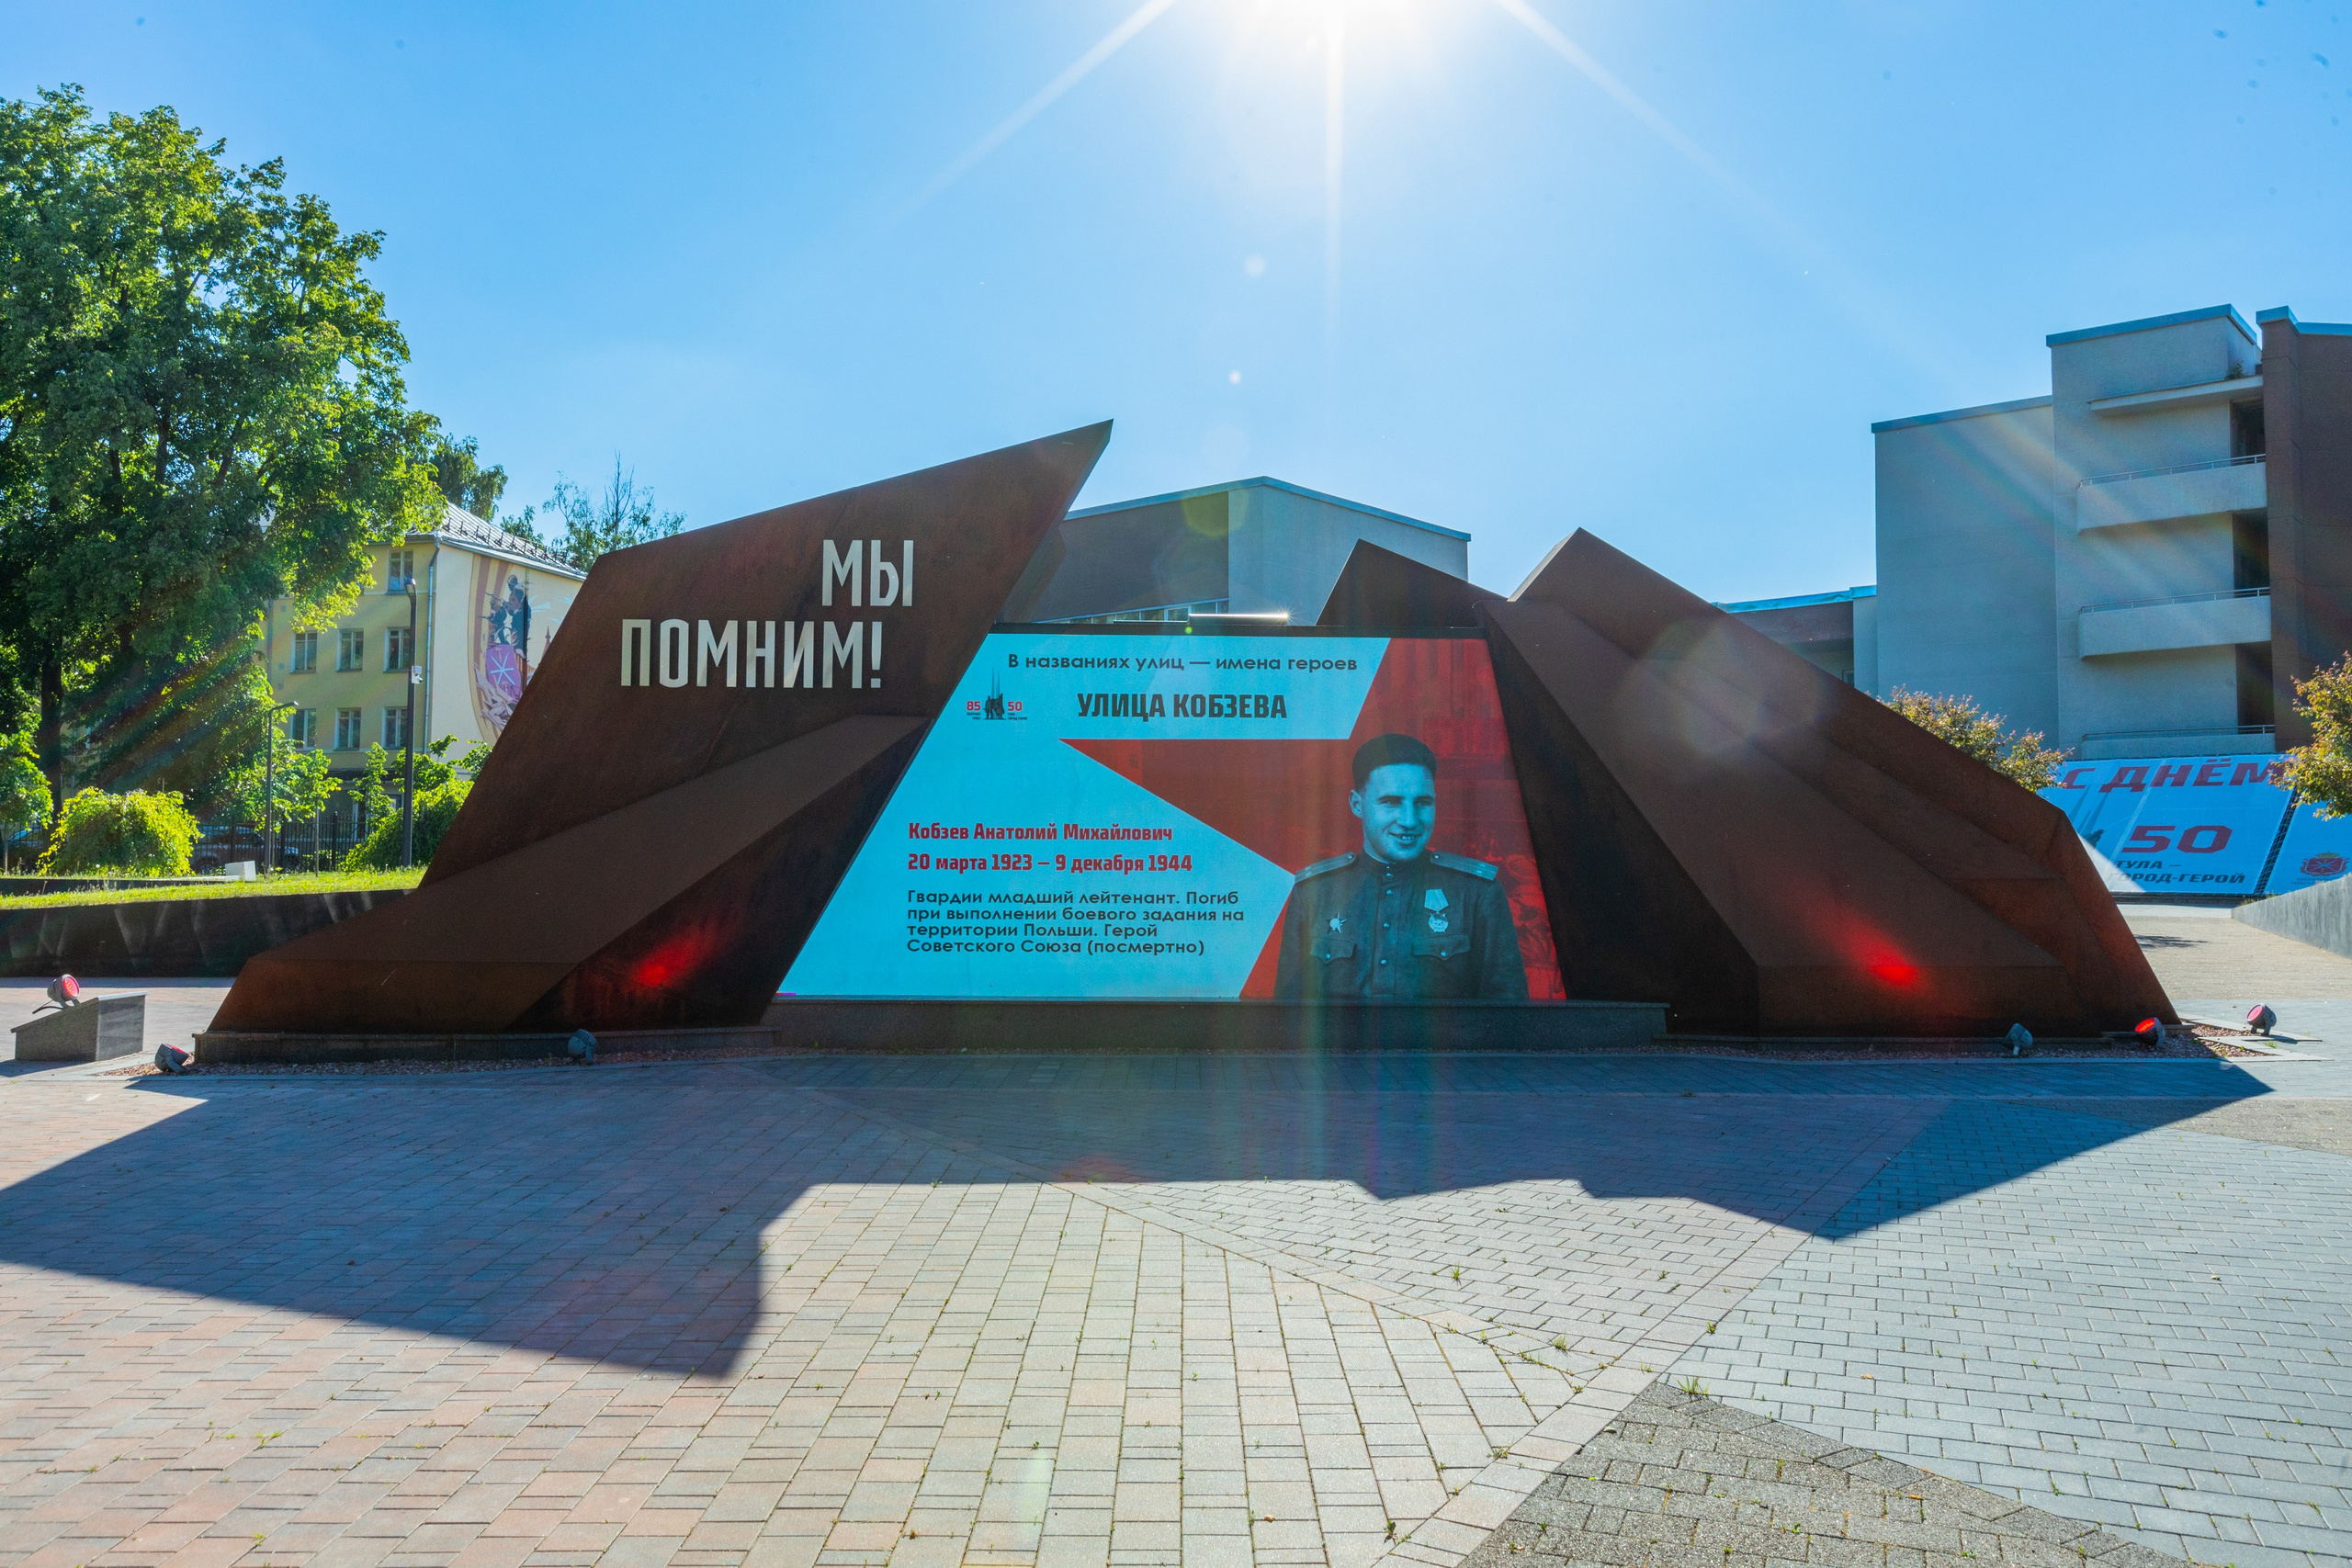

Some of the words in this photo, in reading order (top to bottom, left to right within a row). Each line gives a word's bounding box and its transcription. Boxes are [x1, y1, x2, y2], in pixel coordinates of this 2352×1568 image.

[822, 539, 914, 607] МЫ
[620, 618, 882, 689] ПОМНИМ!
[1009, 654, 1019, 668] В
[1025, 657, 1130, 669] названиях
[1136, 658, 1184, 671] улиц
[1216, 658, 1281, 670] имена
[1288, 659, 1358, 673] героев
[966, 700, 981, 711] 85
[1007, 701, 1023, 712] 50
[1077, 693, 1166, 723] УЛИЦА
[1172, 694, 1287, 718] КОБЗЕВА
[2062, 767, 2097, 789] С
[2098, 758, 2286, 794] ДНЁМ
[909, 822, 969, 840] Кобзев
[973, 822, 1057, 840] Анатолий
[1063, 823, 1172, 840] Михайлович
[2121, 826, 2233, 853] 50
[908, 853, 930, 870] 20
[935, 857, 987, 874] марта
[991, 853, 1033, 871] 1923
[1055, 853, 1067, 871] 9
[1070, 853, 1144, 875] декабря
[1148, 854, 1193, 872] 1944
[2115, 860, 2163, 869] ТУЛА
[2108, 873, 2245, 884] ГОРОД-ГЕРОЙ
[908, 890, 982, 906] Гвардии
[988, 891, 1074, 905] младший
[1079, 891, 1180, 905] лейтенант.
[1186, 891, 1238, 905] Погиб
[908, 908, 940, 922] при
[946, 909, 1057, 920] выполнении
[1062, 908, 1136, 920] боевого
[1143, 910, 1216, 922] задания
[1222, 910, 1244, 921] на
[907, 925, 1018, 939] территории
[1023, 923, 1098, 937] Польши.
[1104, 924, 1158, 939] Герой
[907, 939, 1015, 953] Советского
[1021, 940, 1081, 953] Союза
[1087, 940, 1204, 956] (посмертно)
